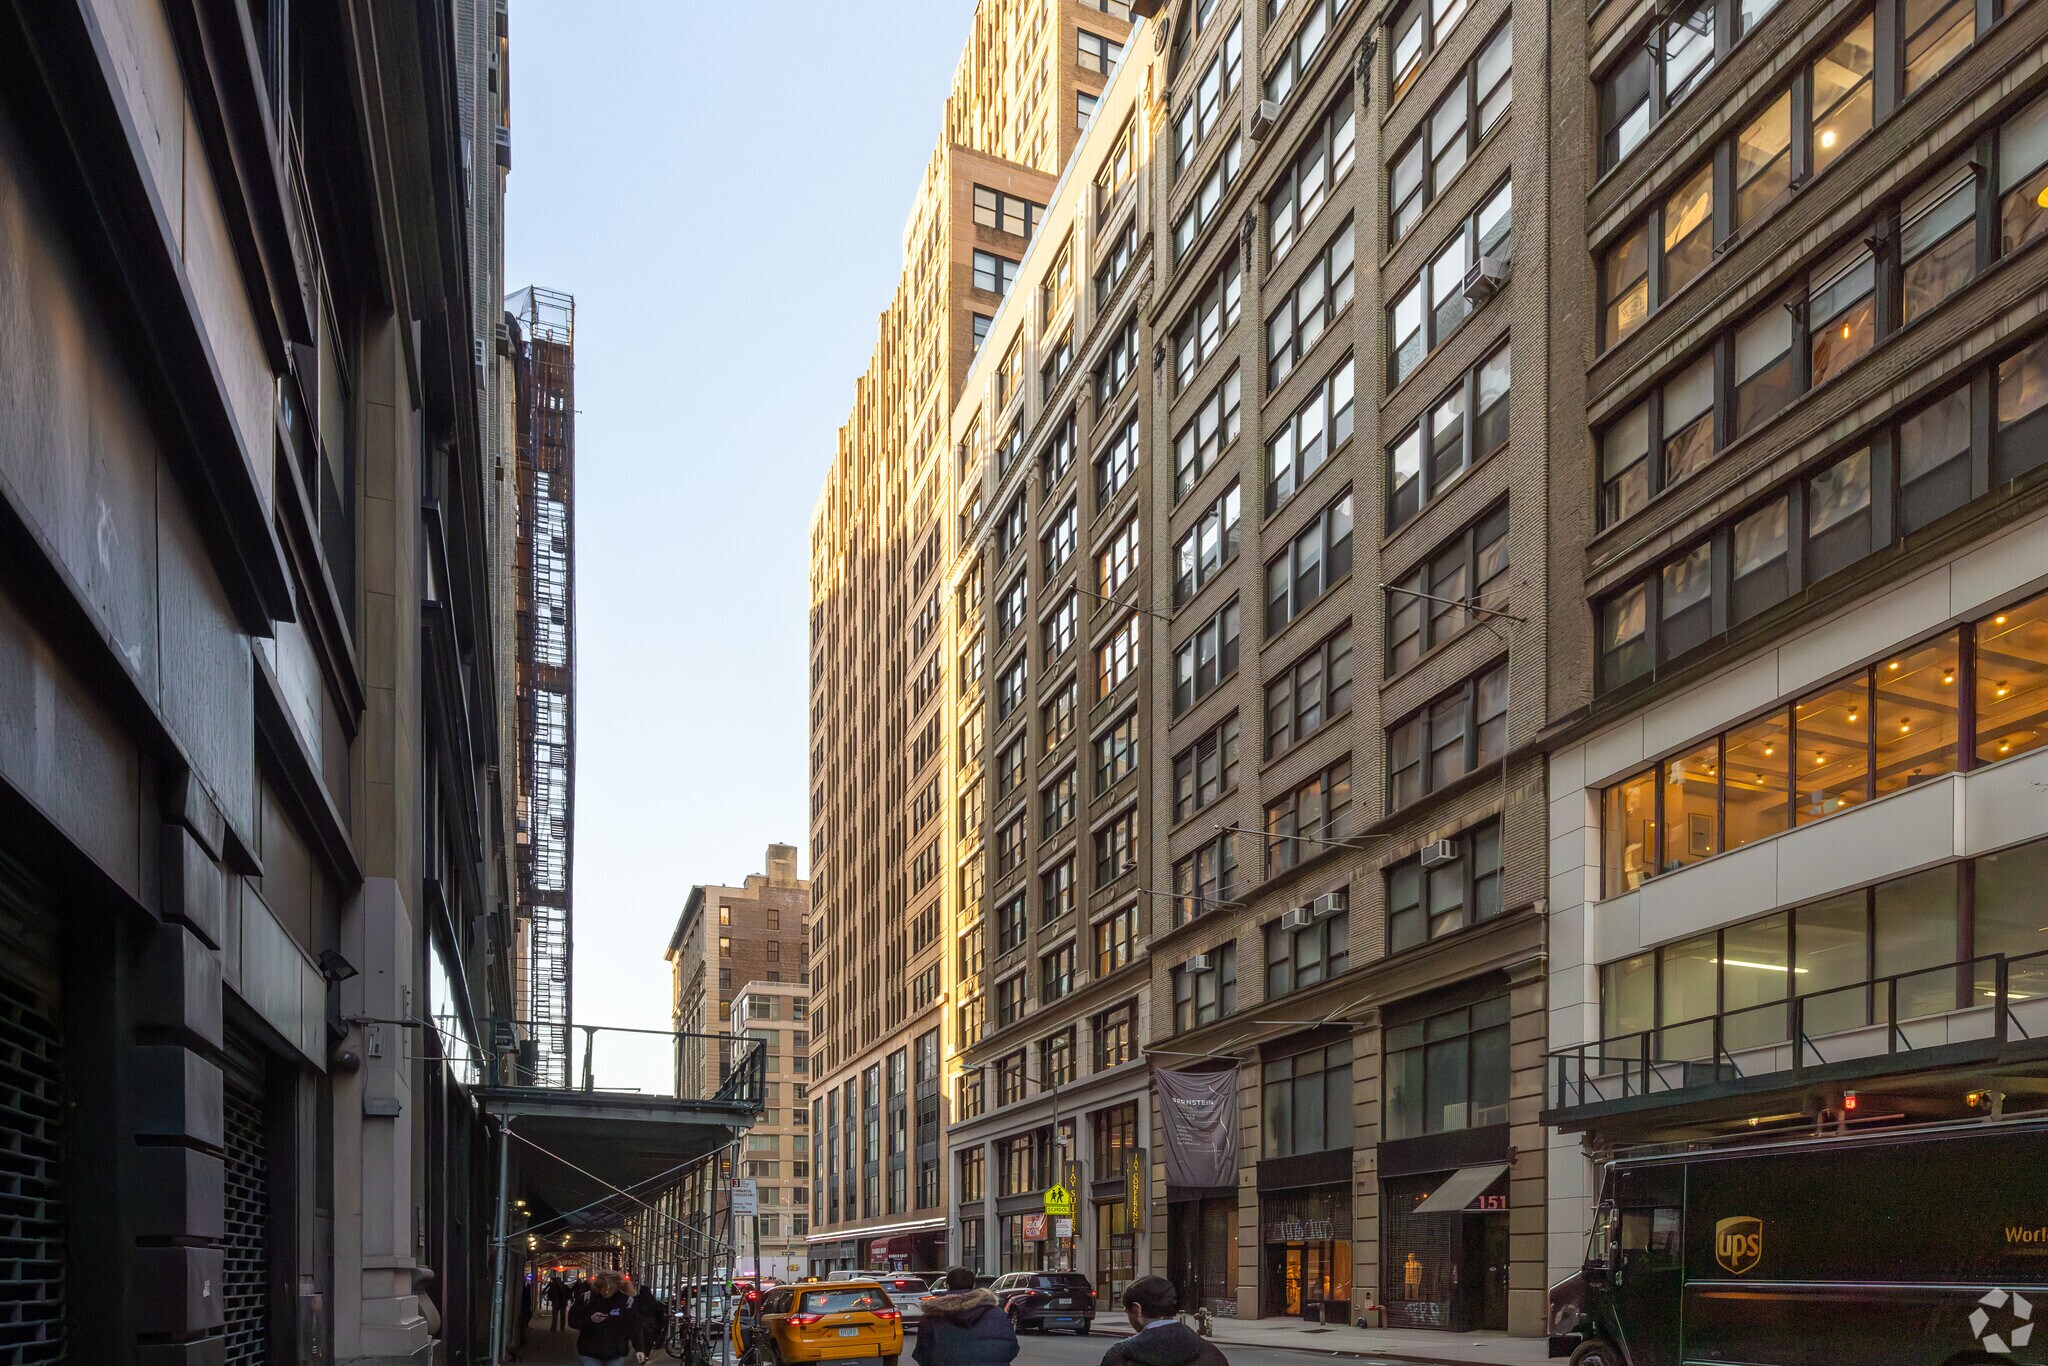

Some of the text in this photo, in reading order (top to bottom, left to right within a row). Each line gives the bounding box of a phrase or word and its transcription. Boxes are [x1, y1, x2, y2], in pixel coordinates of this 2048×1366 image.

[1172, 1097, 1214, 1106] BERNSTEIN
[1479, 1195, 1506, 1209] 151
[2005, 1226, 2048, 1242] Worl
[1718, 1233, 1759, 1266] ups
